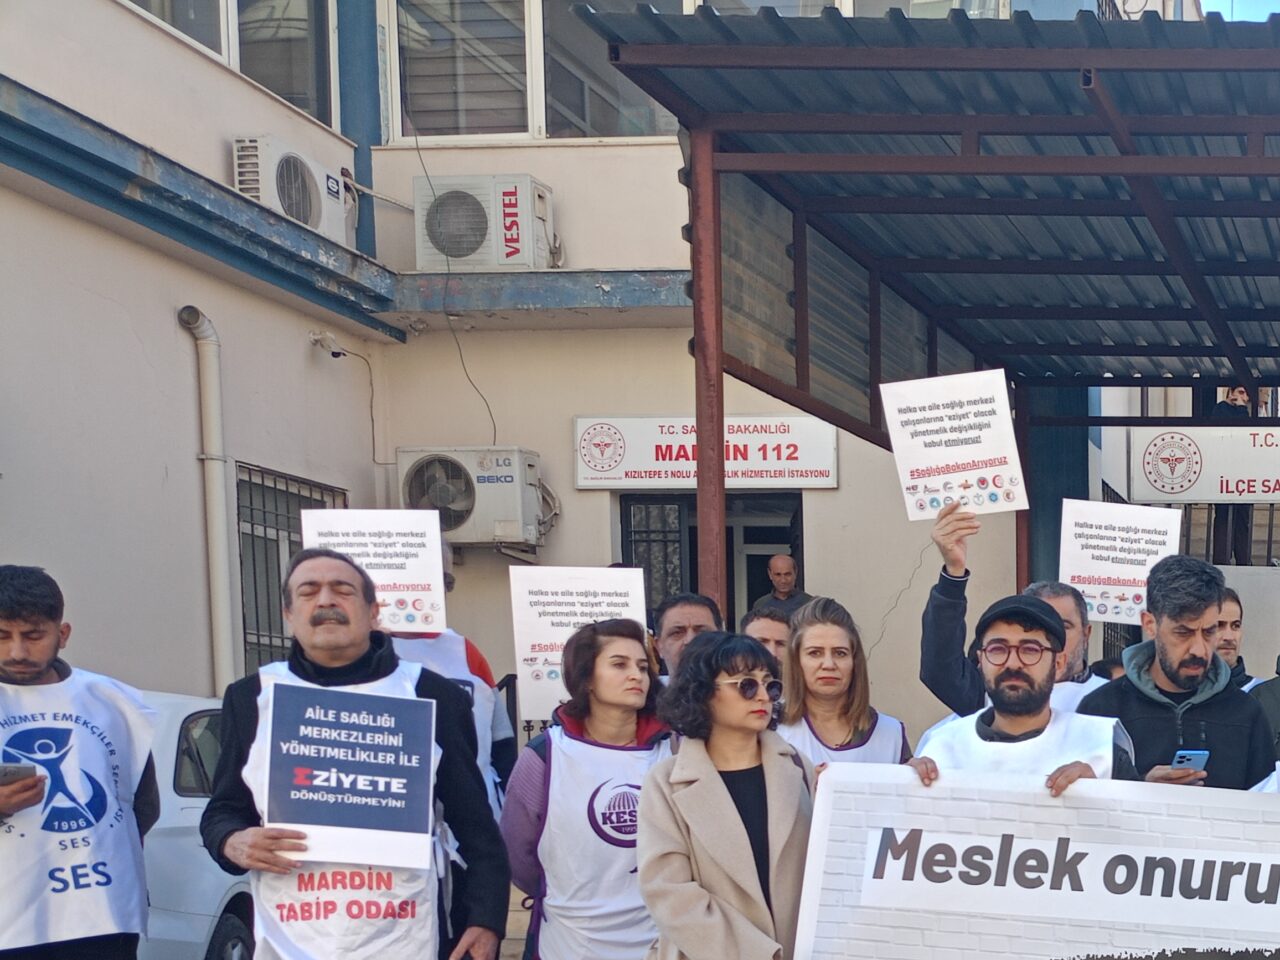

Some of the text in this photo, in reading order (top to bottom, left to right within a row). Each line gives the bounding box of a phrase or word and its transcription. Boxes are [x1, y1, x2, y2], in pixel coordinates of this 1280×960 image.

[502, 185, 520, 259] VESTEL
[658, 424, 678, 435] T.C.
[727, 421, 790, 435] BAKANLIĞI
[655, 440, 799, 461] MAİN 112
[1250, 433, 1279, 448] T.C.
[495, 457, 512, 467] LG
[476, 475, 514, 484] BEKO
[624, 470, 662, 479] KIZILTEPE
[664, 471, 669, 479] 5
[670, 470, 691, 479] NOLU
[741, 468, 786, 479] HİZMETLERİ
[787, 467, 830, 478] İSTASYONU
[1219, 475, 1257, 496] İLÇE
[0, 712, 47, 729] HİZMET
[305, 705, 395, 728] AİLE SAĞLIĞI
[299, 724, 403, 747] MERKEZLERİNİ
[279, 740, 420, 767] YÖNETMELİKLER İLE
[290, 789, 406, 808] DÖNÜŞTÜRMEYİN!
[53, 818, 87, 831] 1996
[601, 809, 637, 825] KES
[58, 835, 91, 851] SES
[872, 826, 1085, 892] Meslek
[48, 860, 113, 893] SES
[297, 866, 393, 892] MARDİN
[276, 896, 417, 923] TABİP ODASI
